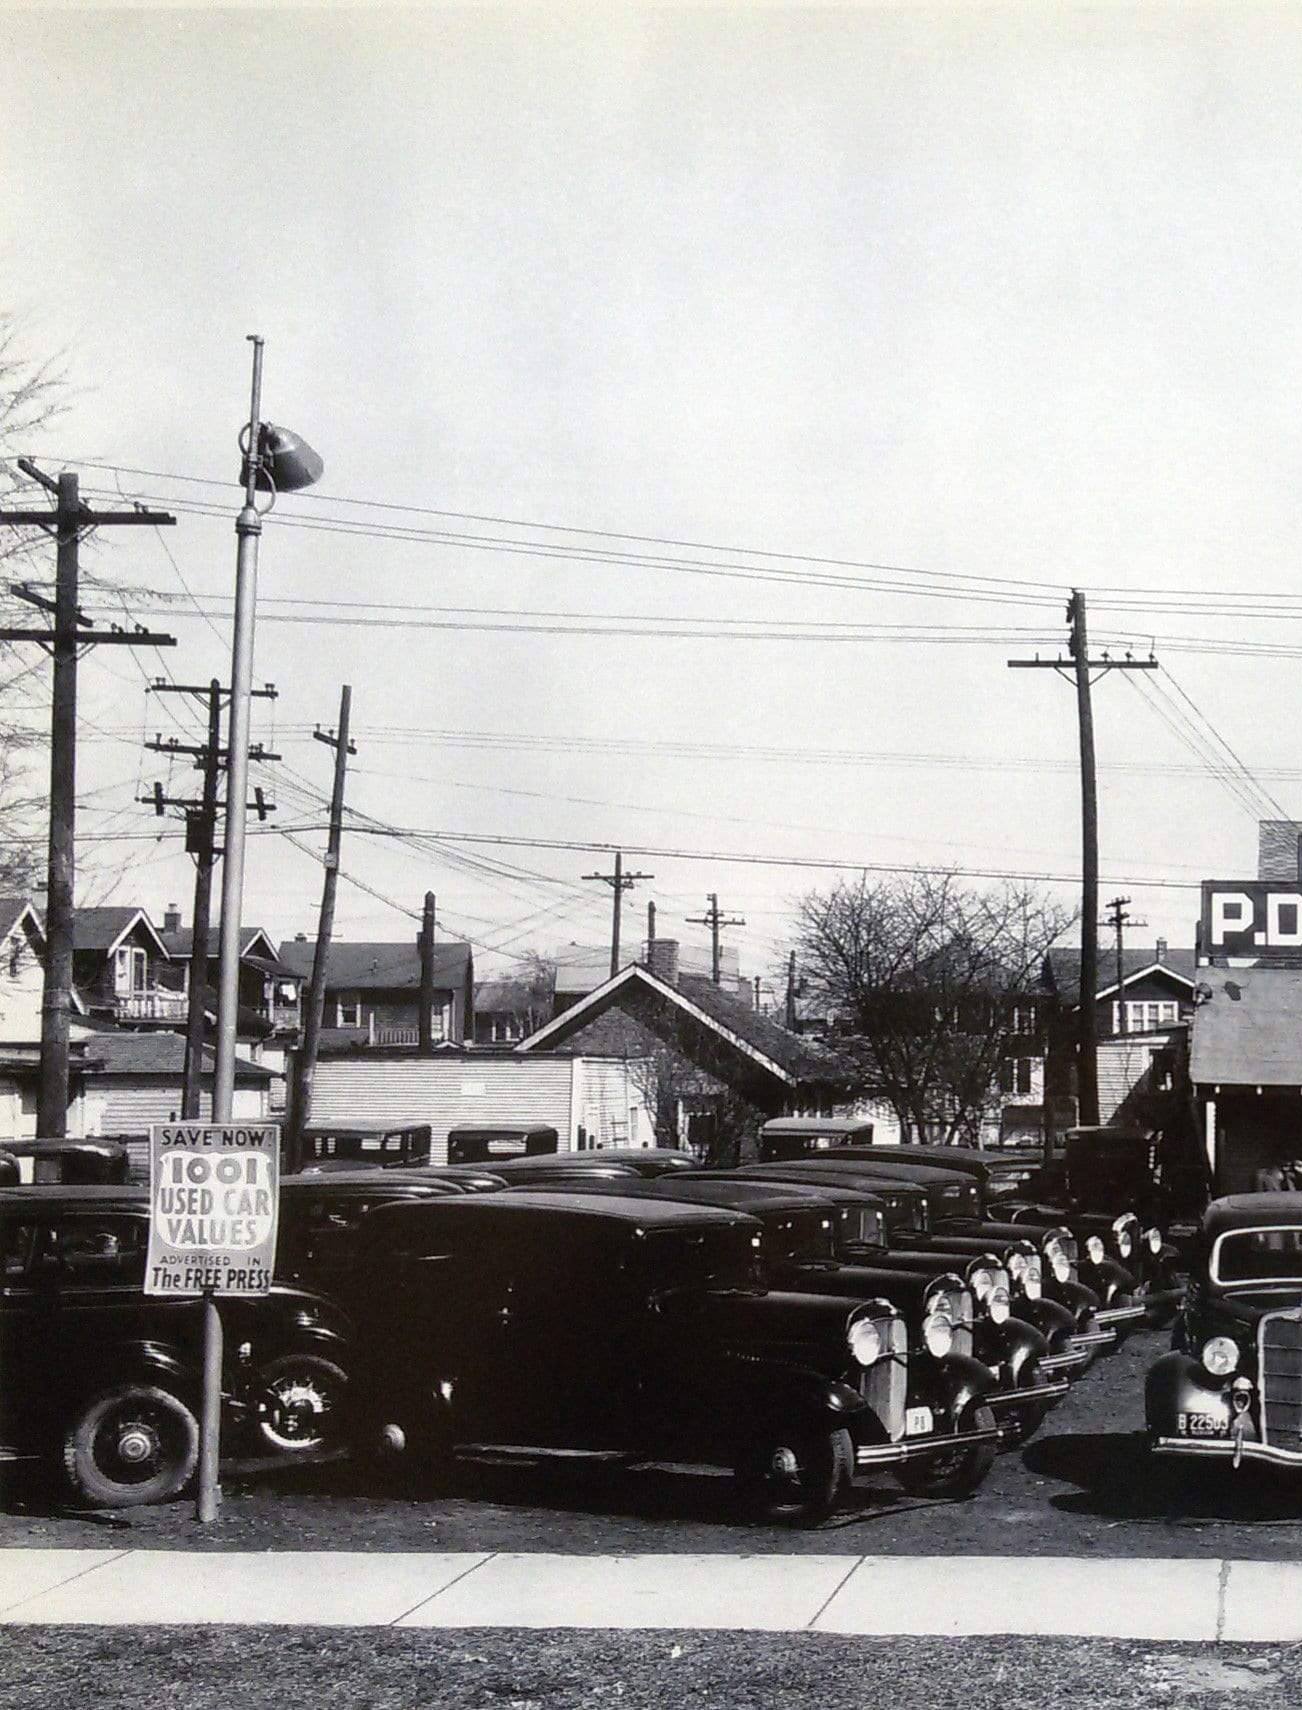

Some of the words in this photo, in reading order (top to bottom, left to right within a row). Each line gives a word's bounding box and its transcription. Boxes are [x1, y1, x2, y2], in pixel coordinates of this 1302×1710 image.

[161, 1129, 212, 1146] SAVE
[222, 1130, 272, 1147] NOW!
[172, 1157, 257, 1184] 1001
[160, 1187, 213, 1215] USED
[224, 1188, 270, 1216] CAR
[167, 1218, 257, 1245] VALUES
[160, 1256, 231, 1266] ADVERTISED
[247, 1257, 261, 1266] IN
[152, 1267, 181, 1288] The
[184, 1268, 222, 1289] FREE
[226, 1268, 271, 1291] PRESS
